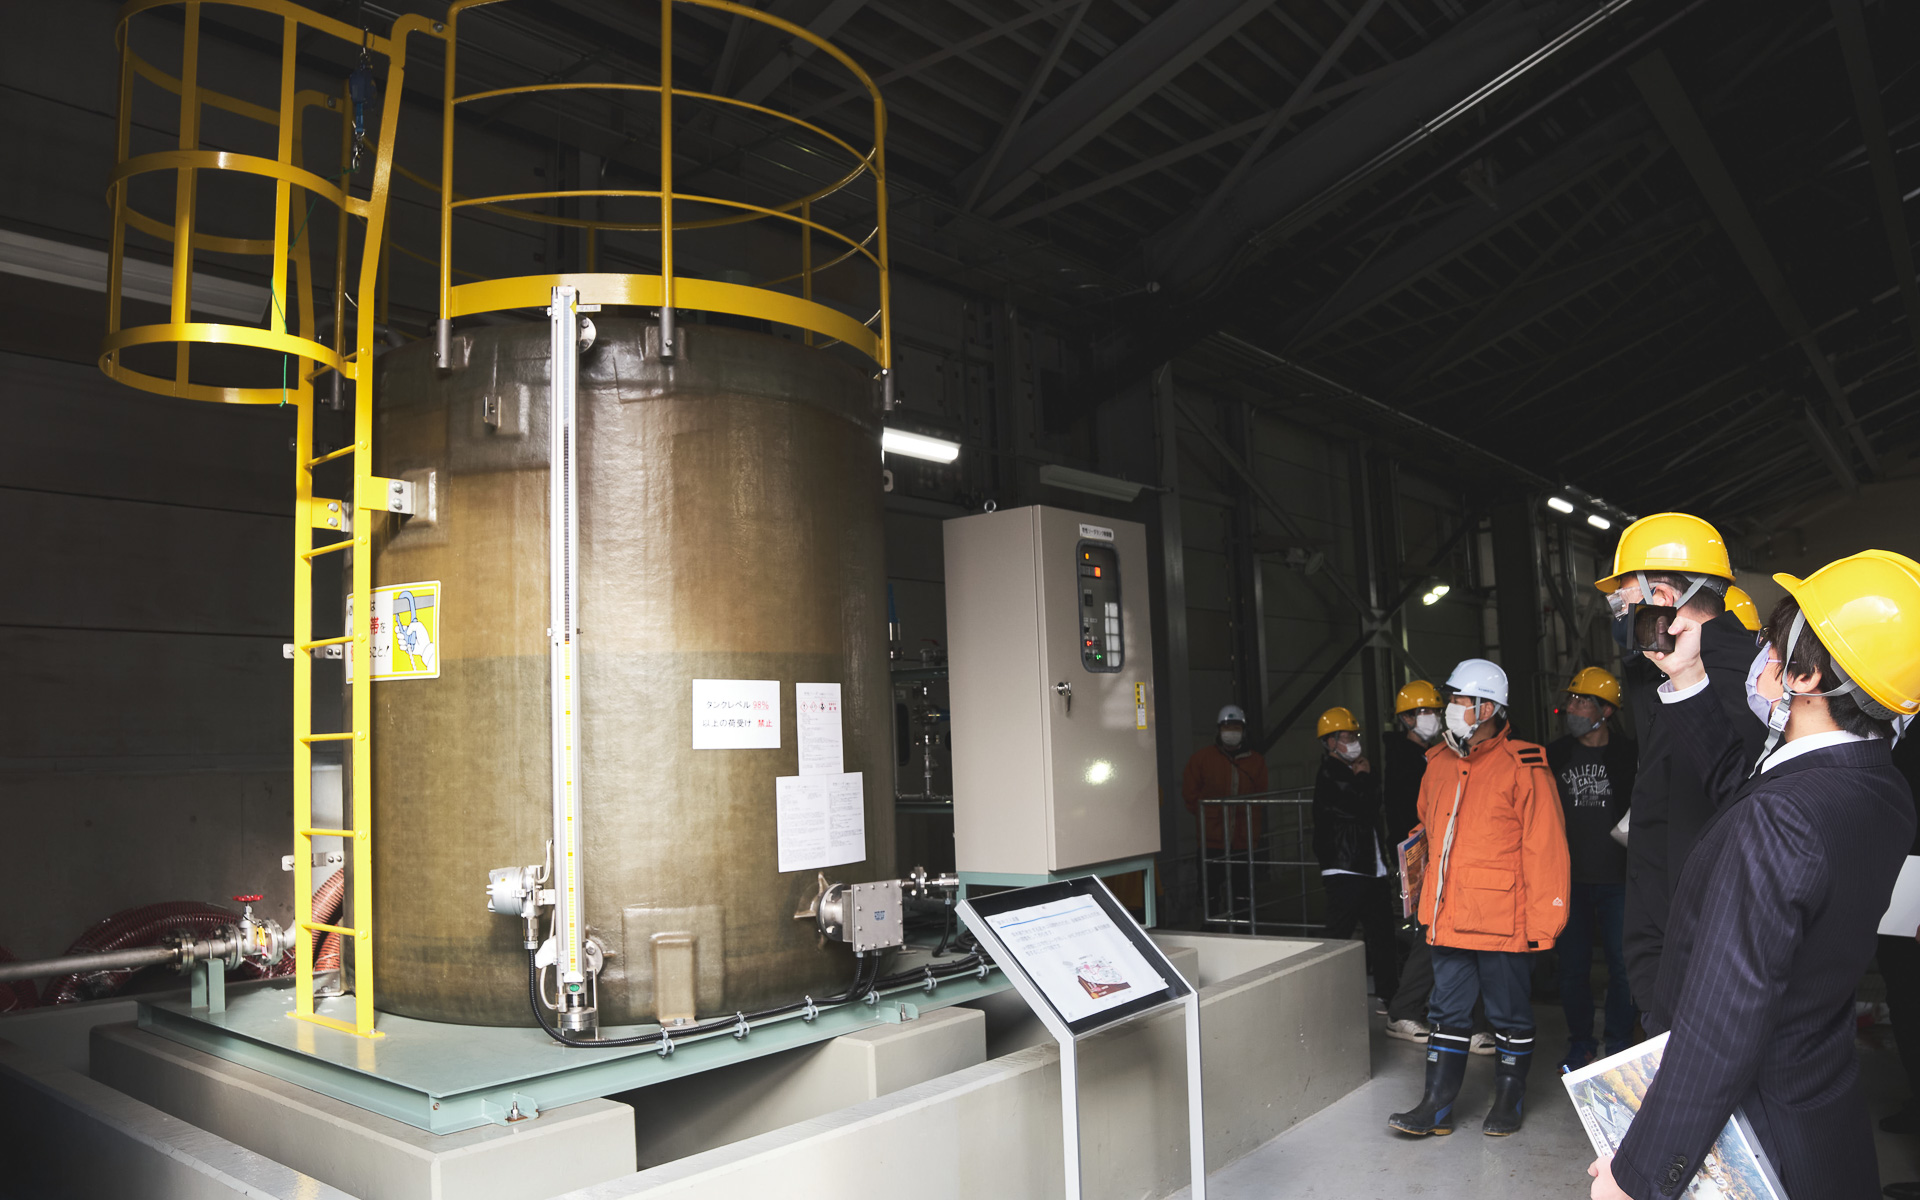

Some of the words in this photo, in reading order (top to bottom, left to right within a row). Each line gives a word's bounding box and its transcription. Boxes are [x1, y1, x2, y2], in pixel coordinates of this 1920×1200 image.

[706, 700, 751, 709] タンクレベル
[752, 700, 769, 710] 98%
[702, 719, 751, 728] 以上の荷受け
[757, 719, 773, 728] 禁止
